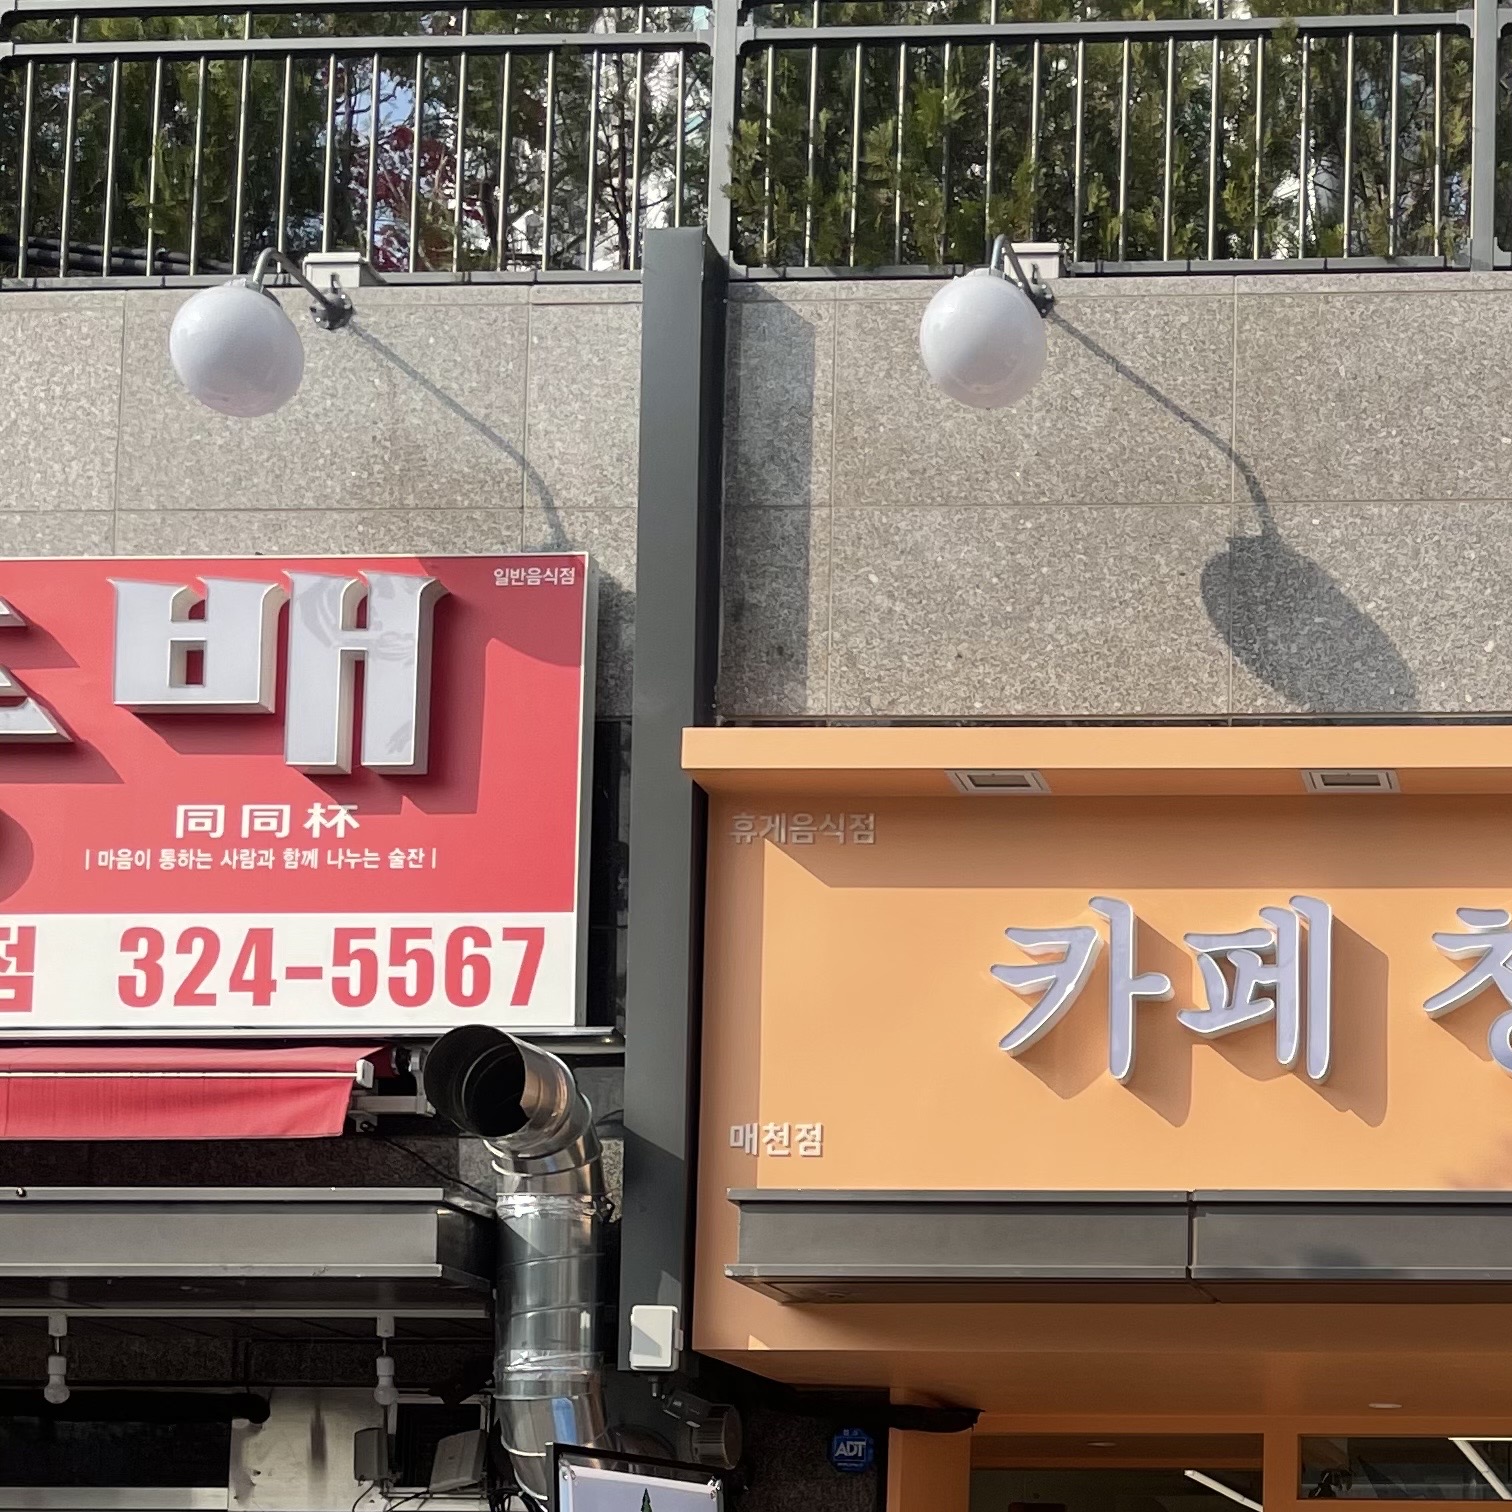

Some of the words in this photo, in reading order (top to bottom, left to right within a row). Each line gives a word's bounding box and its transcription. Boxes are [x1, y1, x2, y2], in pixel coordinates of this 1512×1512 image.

[494, 567, 575, 586] 일반음식점
[0, 570, 450, 775] 배
[176, 803, 360, 838] 同同杯
[730, 812, 876, 844] 휴게음식점
[98, 848, 151, 870] 마음이
[159, 848, 213, 870] 통하는
[220, 848, 276, 870] 사람과
[283, 848, 318, 870] 함께
[327, 848, 380, 869] 나누는
[388, 848, 426, 869] 술잔
[117, 926, 546, 1009] 324-5567
[989, 894, 1333, 1086] 카페
[730, 1122, 823, 1157] 매천점
[835, 1441, 866, 1457] ADT
